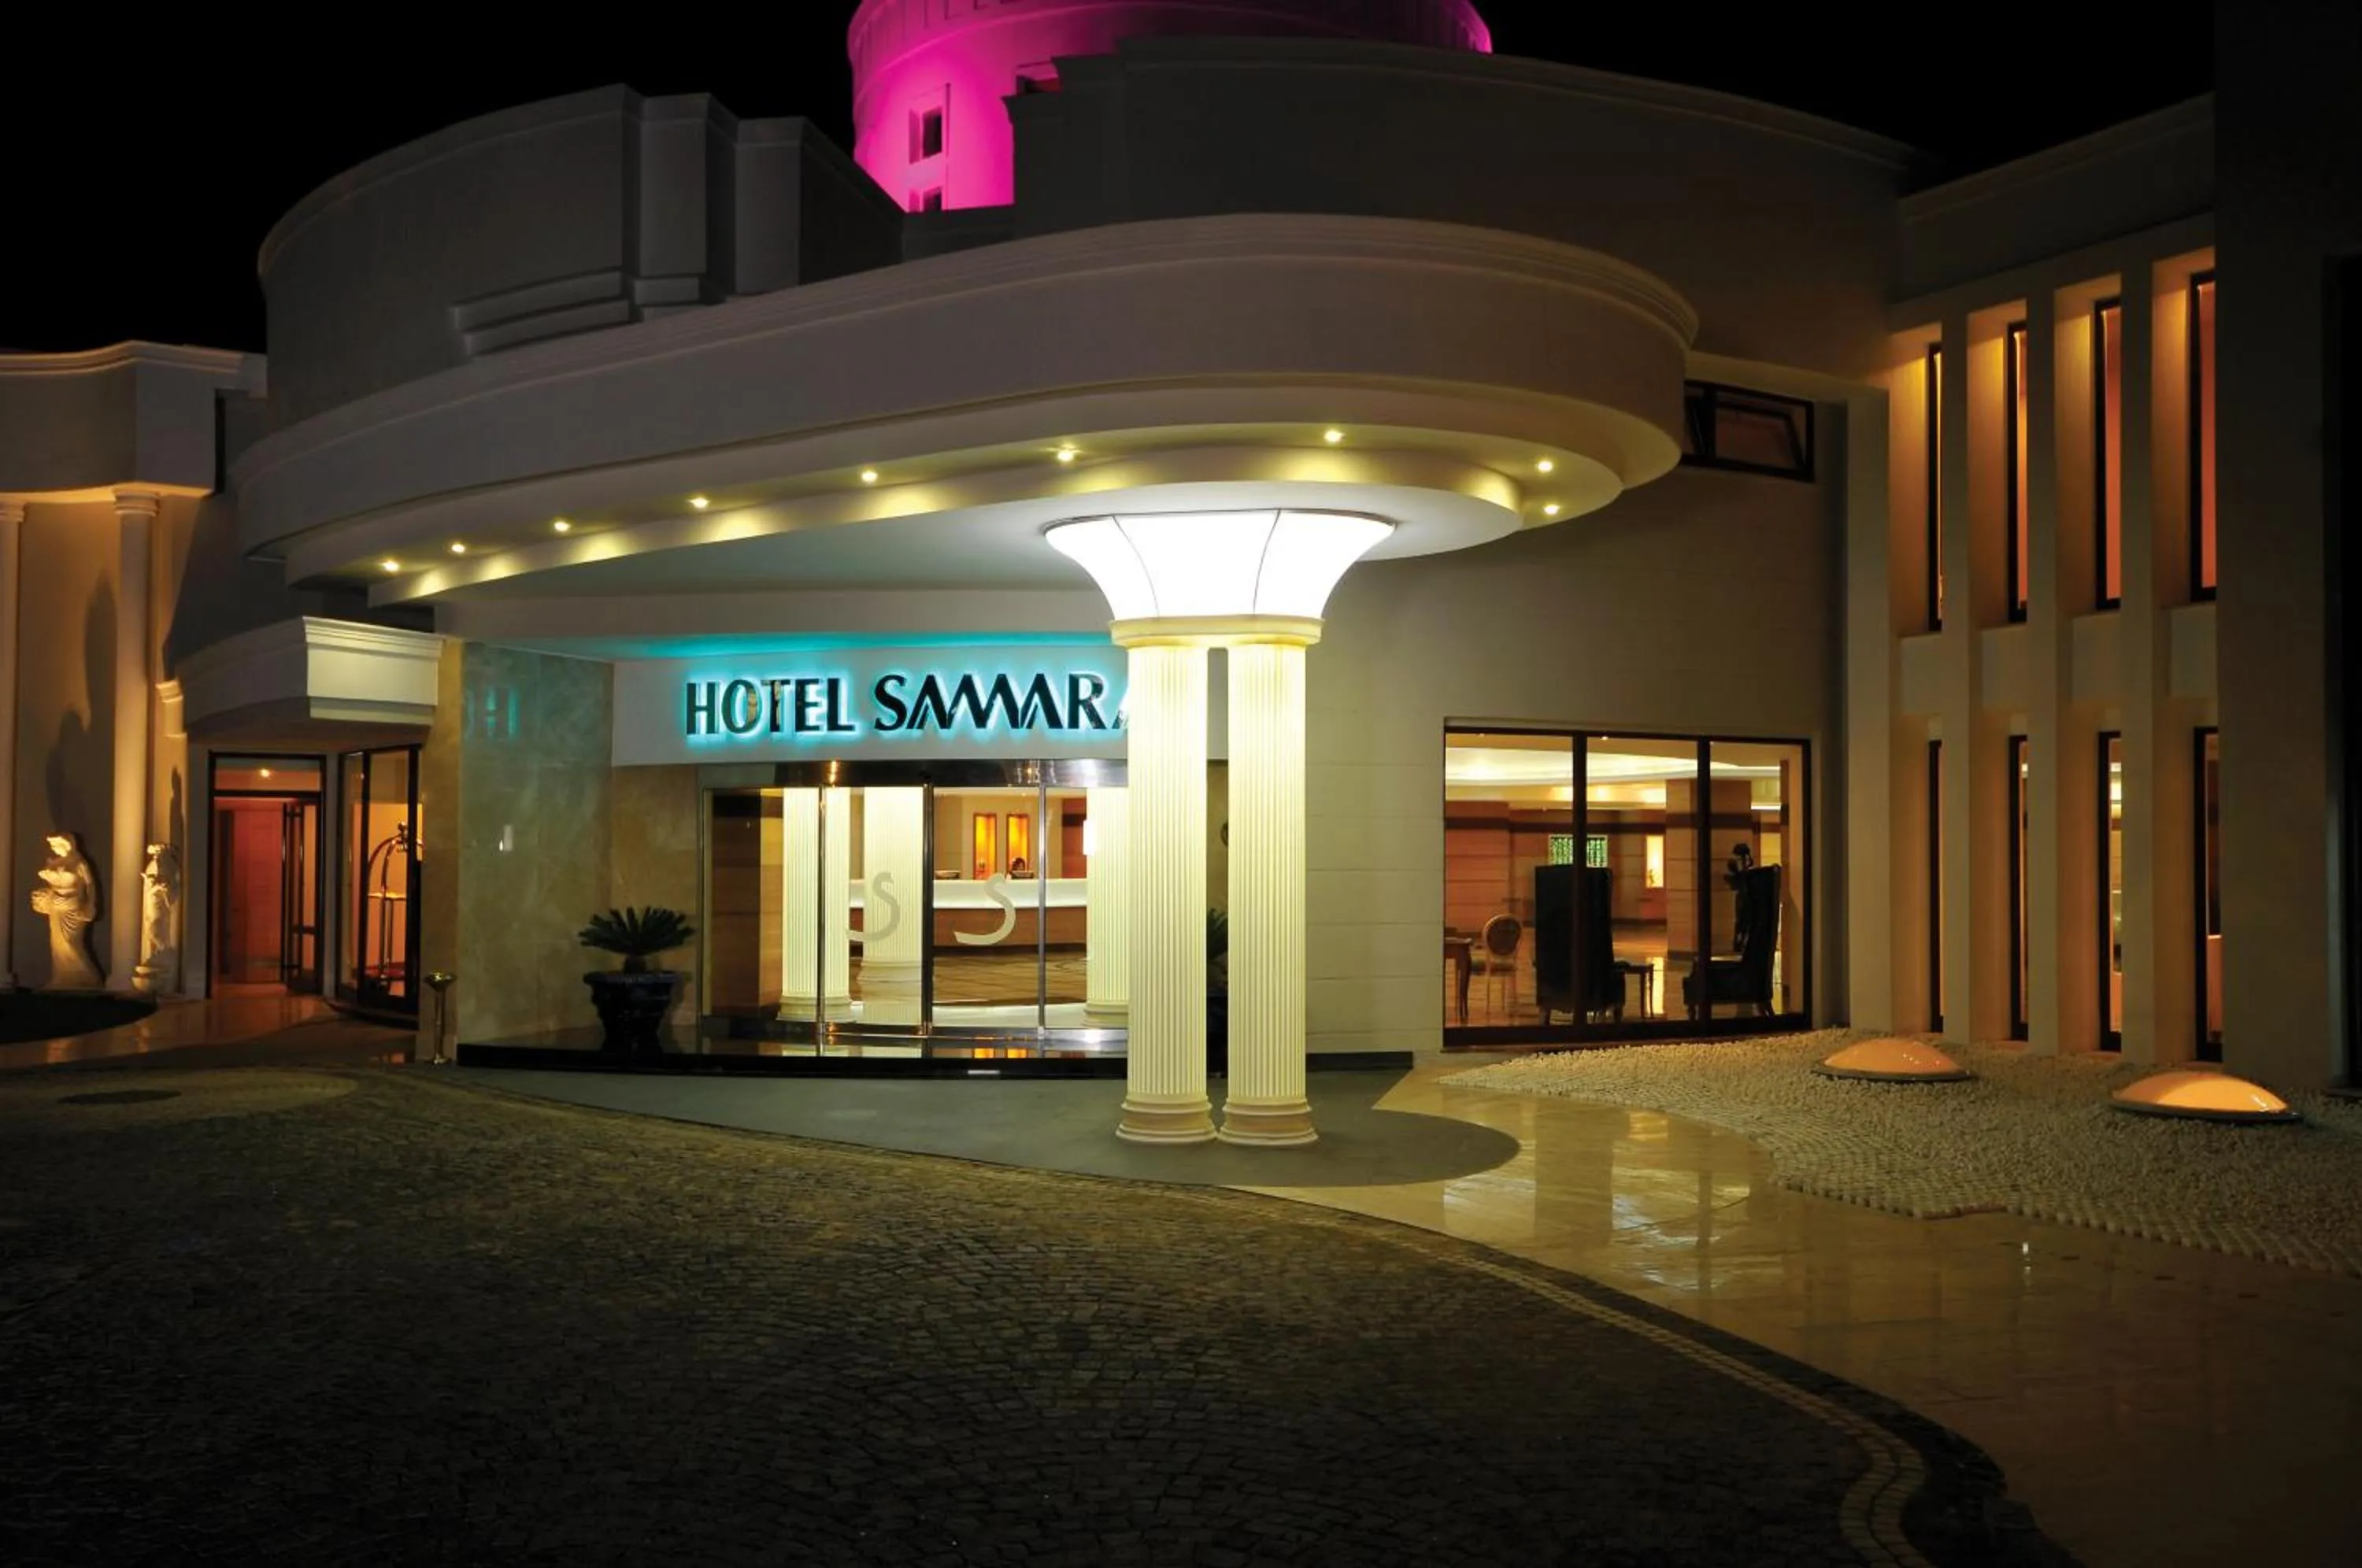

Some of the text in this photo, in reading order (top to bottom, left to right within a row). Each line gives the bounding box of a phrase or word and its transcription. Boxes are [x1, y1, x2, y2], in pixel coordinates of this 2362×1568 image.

[686, 673, 1127, 734] HOTEL SAMAR
[953, 873, 1016, 945] S
